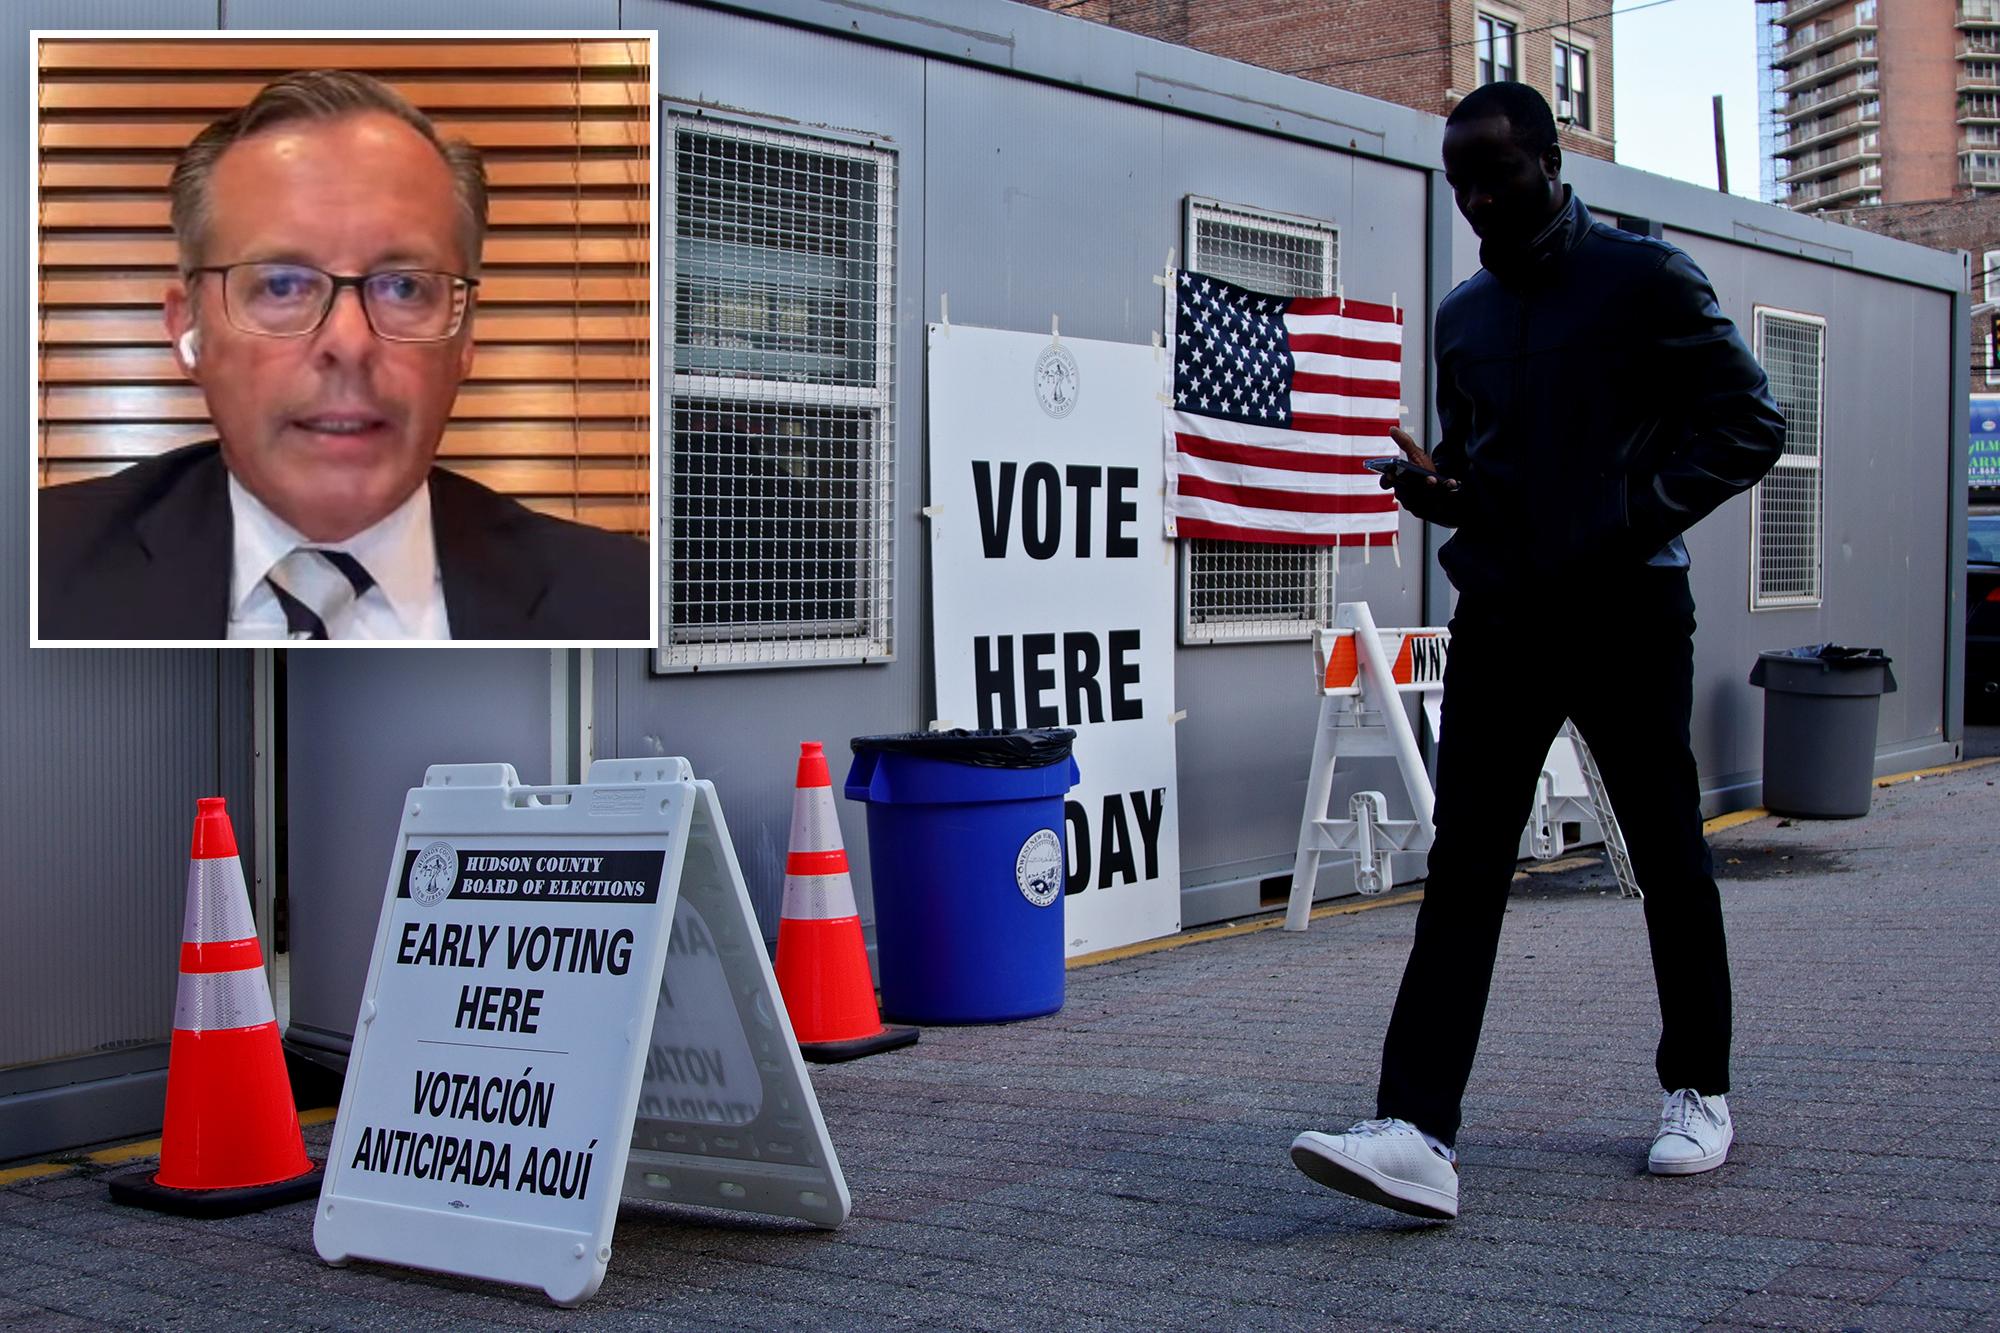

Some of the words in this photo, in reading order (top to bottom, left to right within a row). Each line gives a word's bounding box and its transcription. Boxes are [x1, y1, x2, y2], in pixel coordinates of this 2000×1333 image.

[972, 461, 1138, 560] VOTE
[974, 630, 1144, 728] HERE
[466, 856, 532, 872] HUDSON
[536, 857, 604, 873] COUNTY
[1065, 787, 1167, 896] DAY
[461, 878, 518, 895] BOARD
[522, 879, 545, 895] OF
[548, 879, 646, 897] ELECTIONS
[397, 923, 500, 968] EARLY
[507, 925, 634, 976] VOTING
[455, 985, 544, 1034] HERE
[414, 1067, 555, 1129] VOTACIÓN
[352, 1126, 511, 1190] ANTICIPADA
[516, 1139, 599, 1200] AQUÍ
